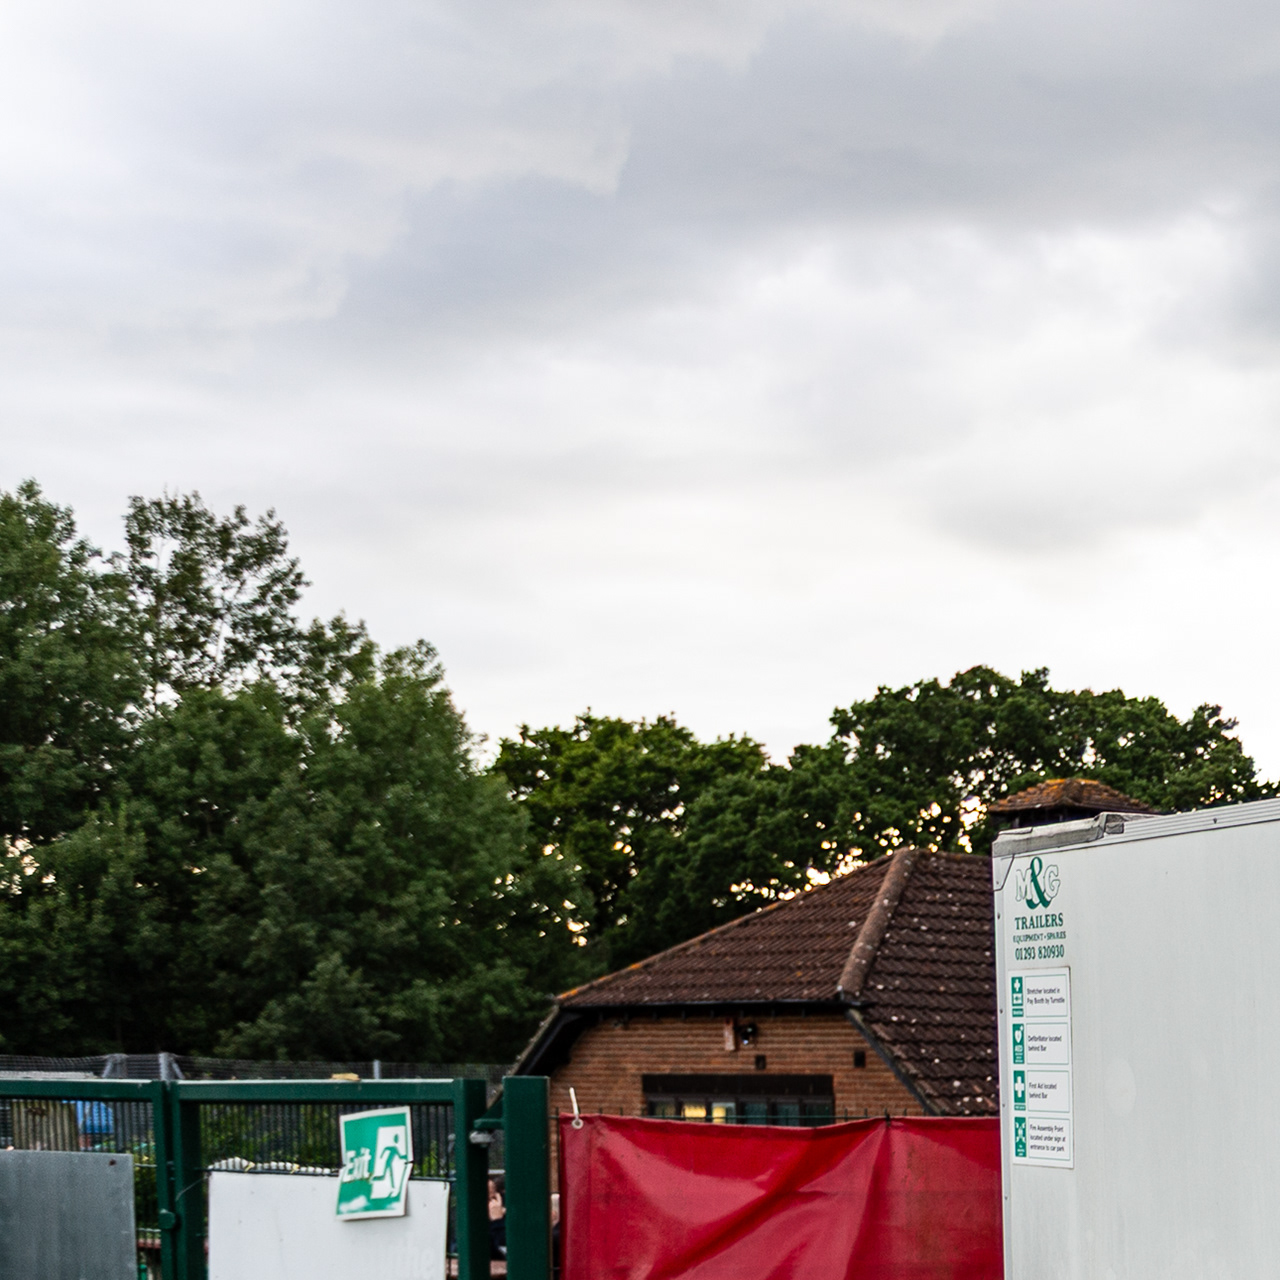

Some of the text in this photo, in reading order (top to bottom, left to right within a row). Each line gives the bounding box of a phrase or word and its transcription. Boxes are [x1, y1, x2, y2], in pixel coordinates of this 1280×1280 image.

[1015, 856, 1061, 909] M&G
[1015, 912, 1064, 930] TRAILERS
[1046, 931, 1066, 941] SPARES
[1015, 943, 1065, 961] 01293 820930
[343, 1147, 372, 1181] Exit
